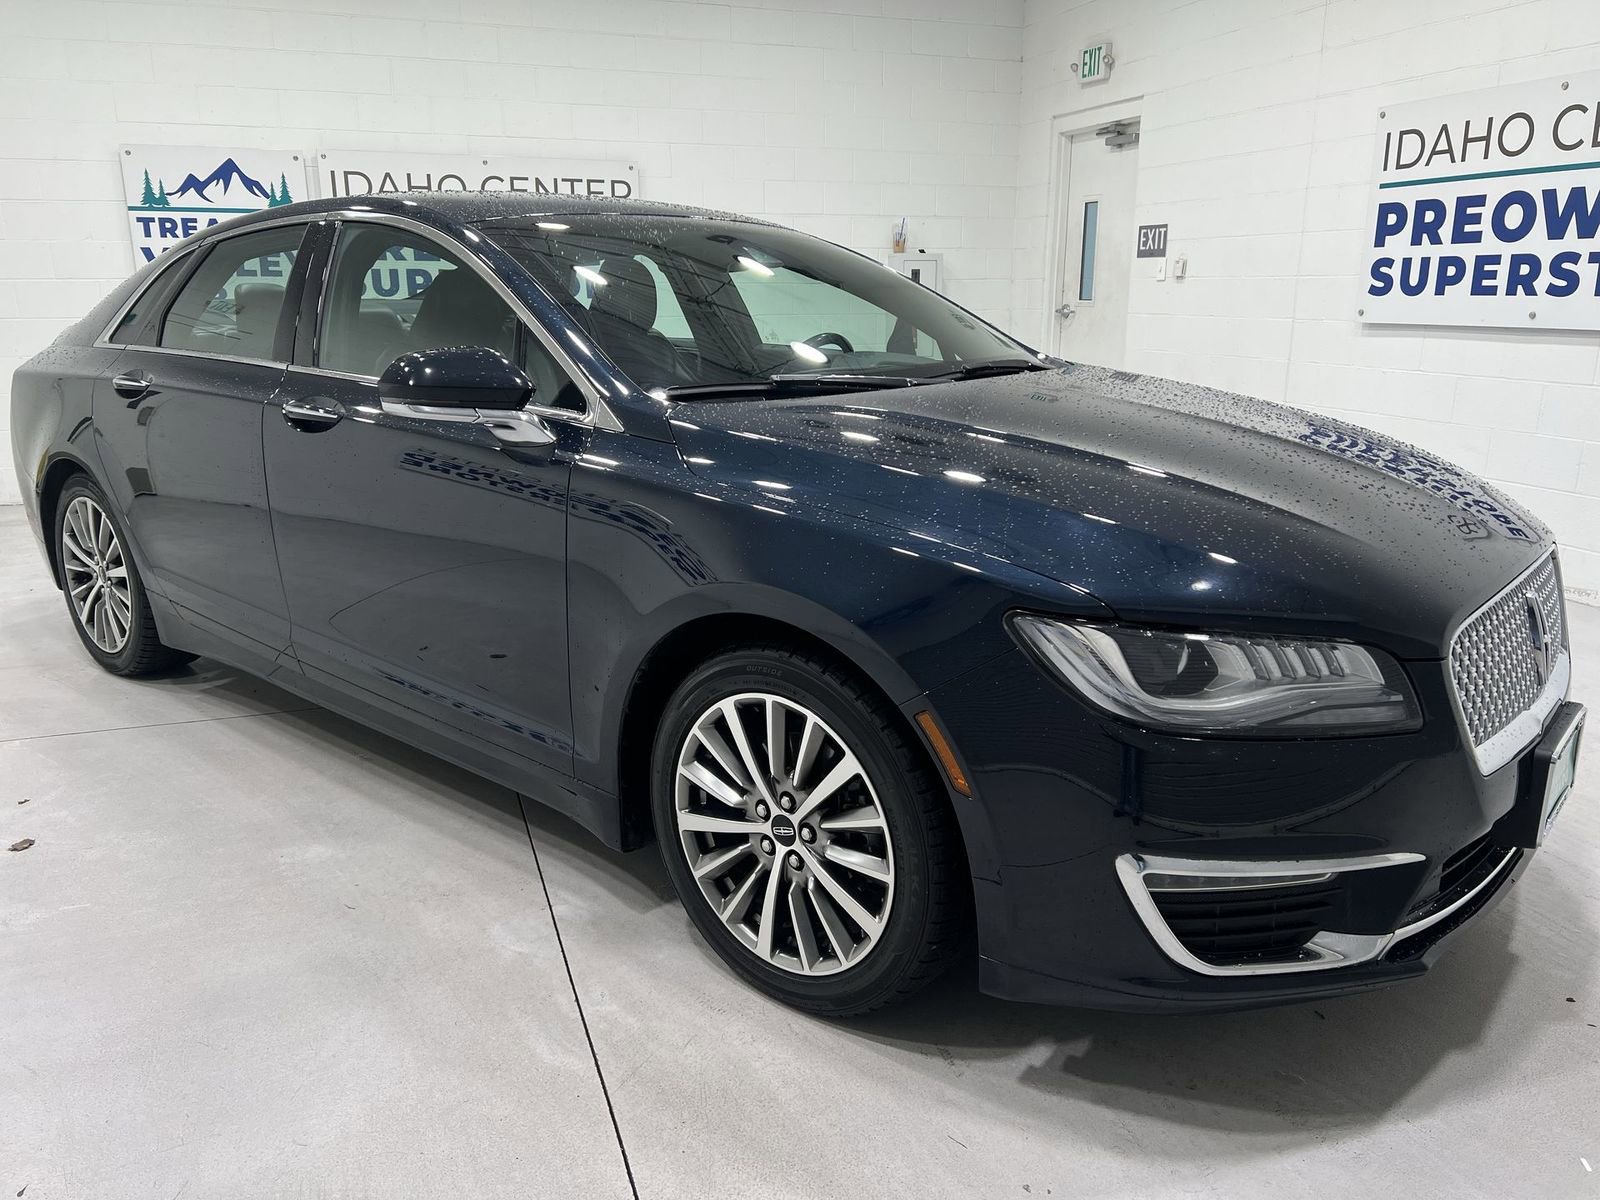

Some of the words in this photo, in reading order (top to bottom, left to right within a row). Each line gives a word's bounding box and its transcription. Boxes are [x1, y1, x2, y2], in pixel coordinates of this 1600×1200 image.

[1082, 46, 1102, 78] EXIT
[1383, 112, 1535, 172] IDAHO
[330, 170, 467, 198] IDAHO
[1140, 228, 1167, 249] EXIT
